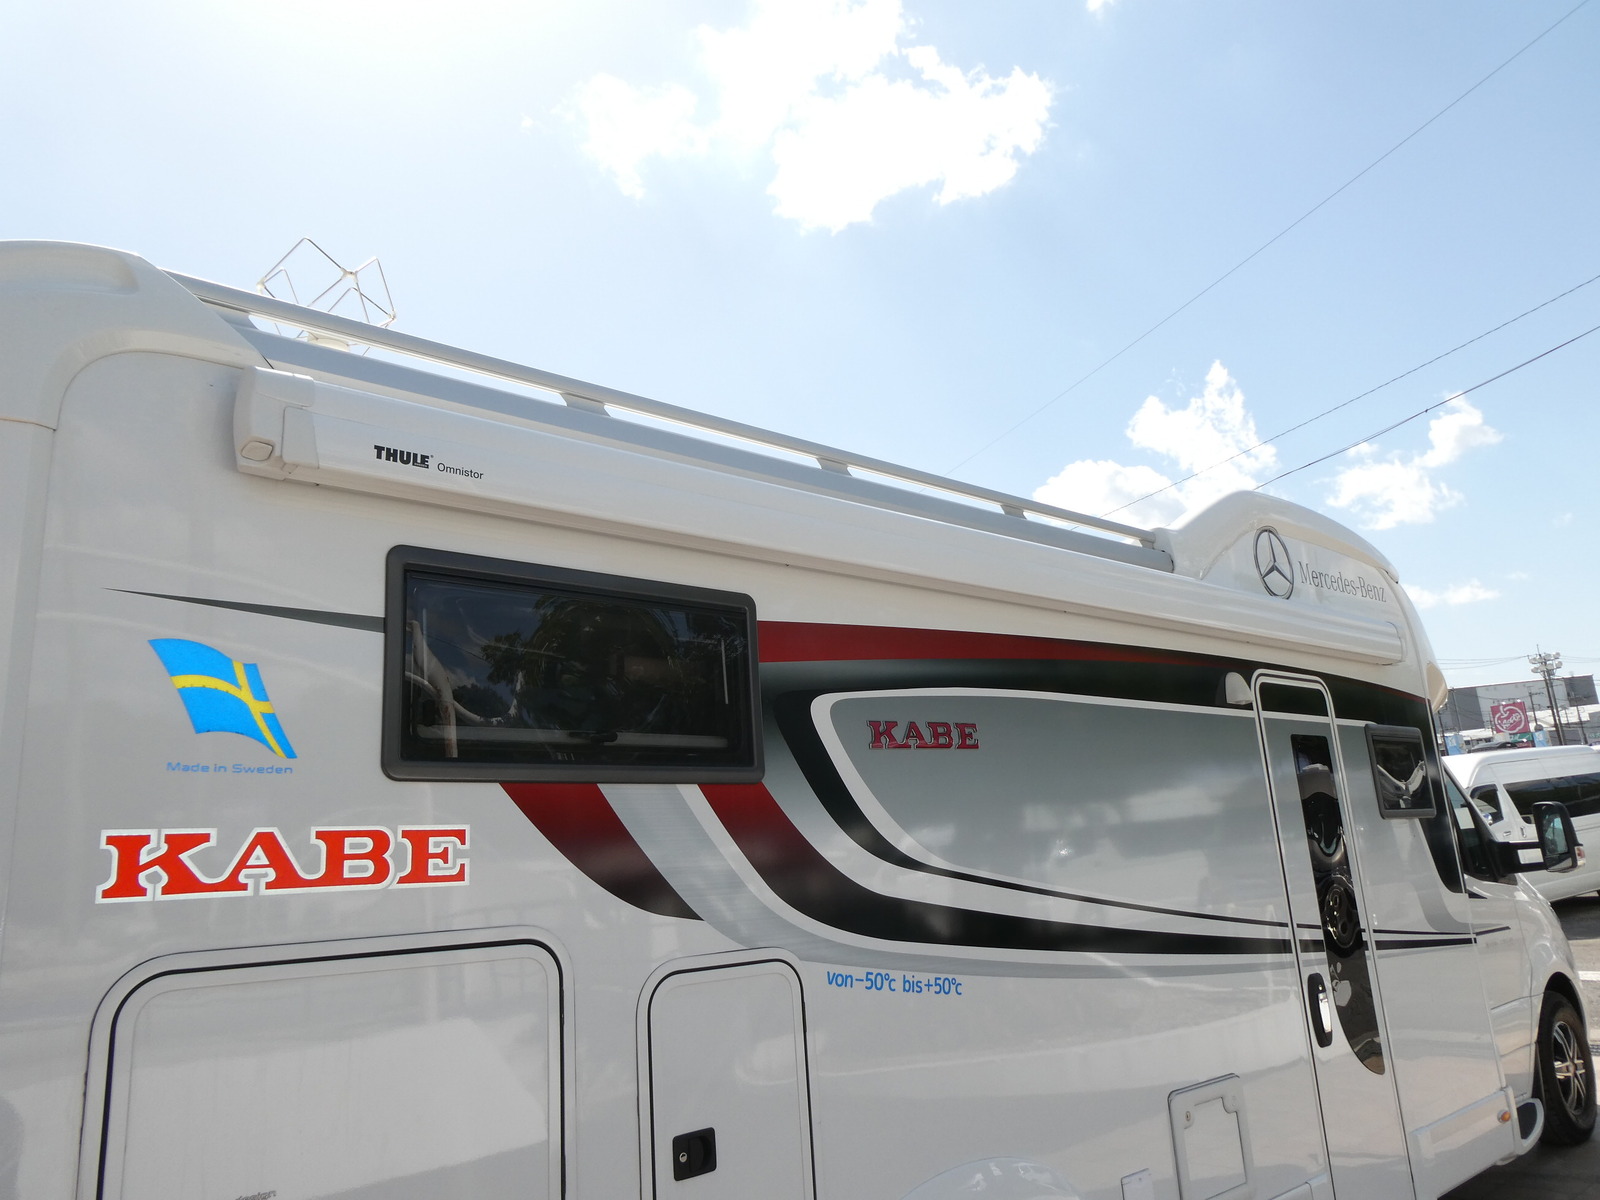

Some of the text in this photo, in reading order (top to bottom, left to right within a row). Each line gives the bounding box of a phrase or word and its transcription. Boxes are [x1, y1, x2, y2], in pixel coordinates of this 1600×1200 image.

[374, 445, 484, 480] THULE Omnistor
[1298, 561, 1387, 602] Mercedes-Benz
[866, 720, 979, 749] KABE
[166, 762, 293, 774] Made in Sweden
[95, 824, 470, 904] KABE
